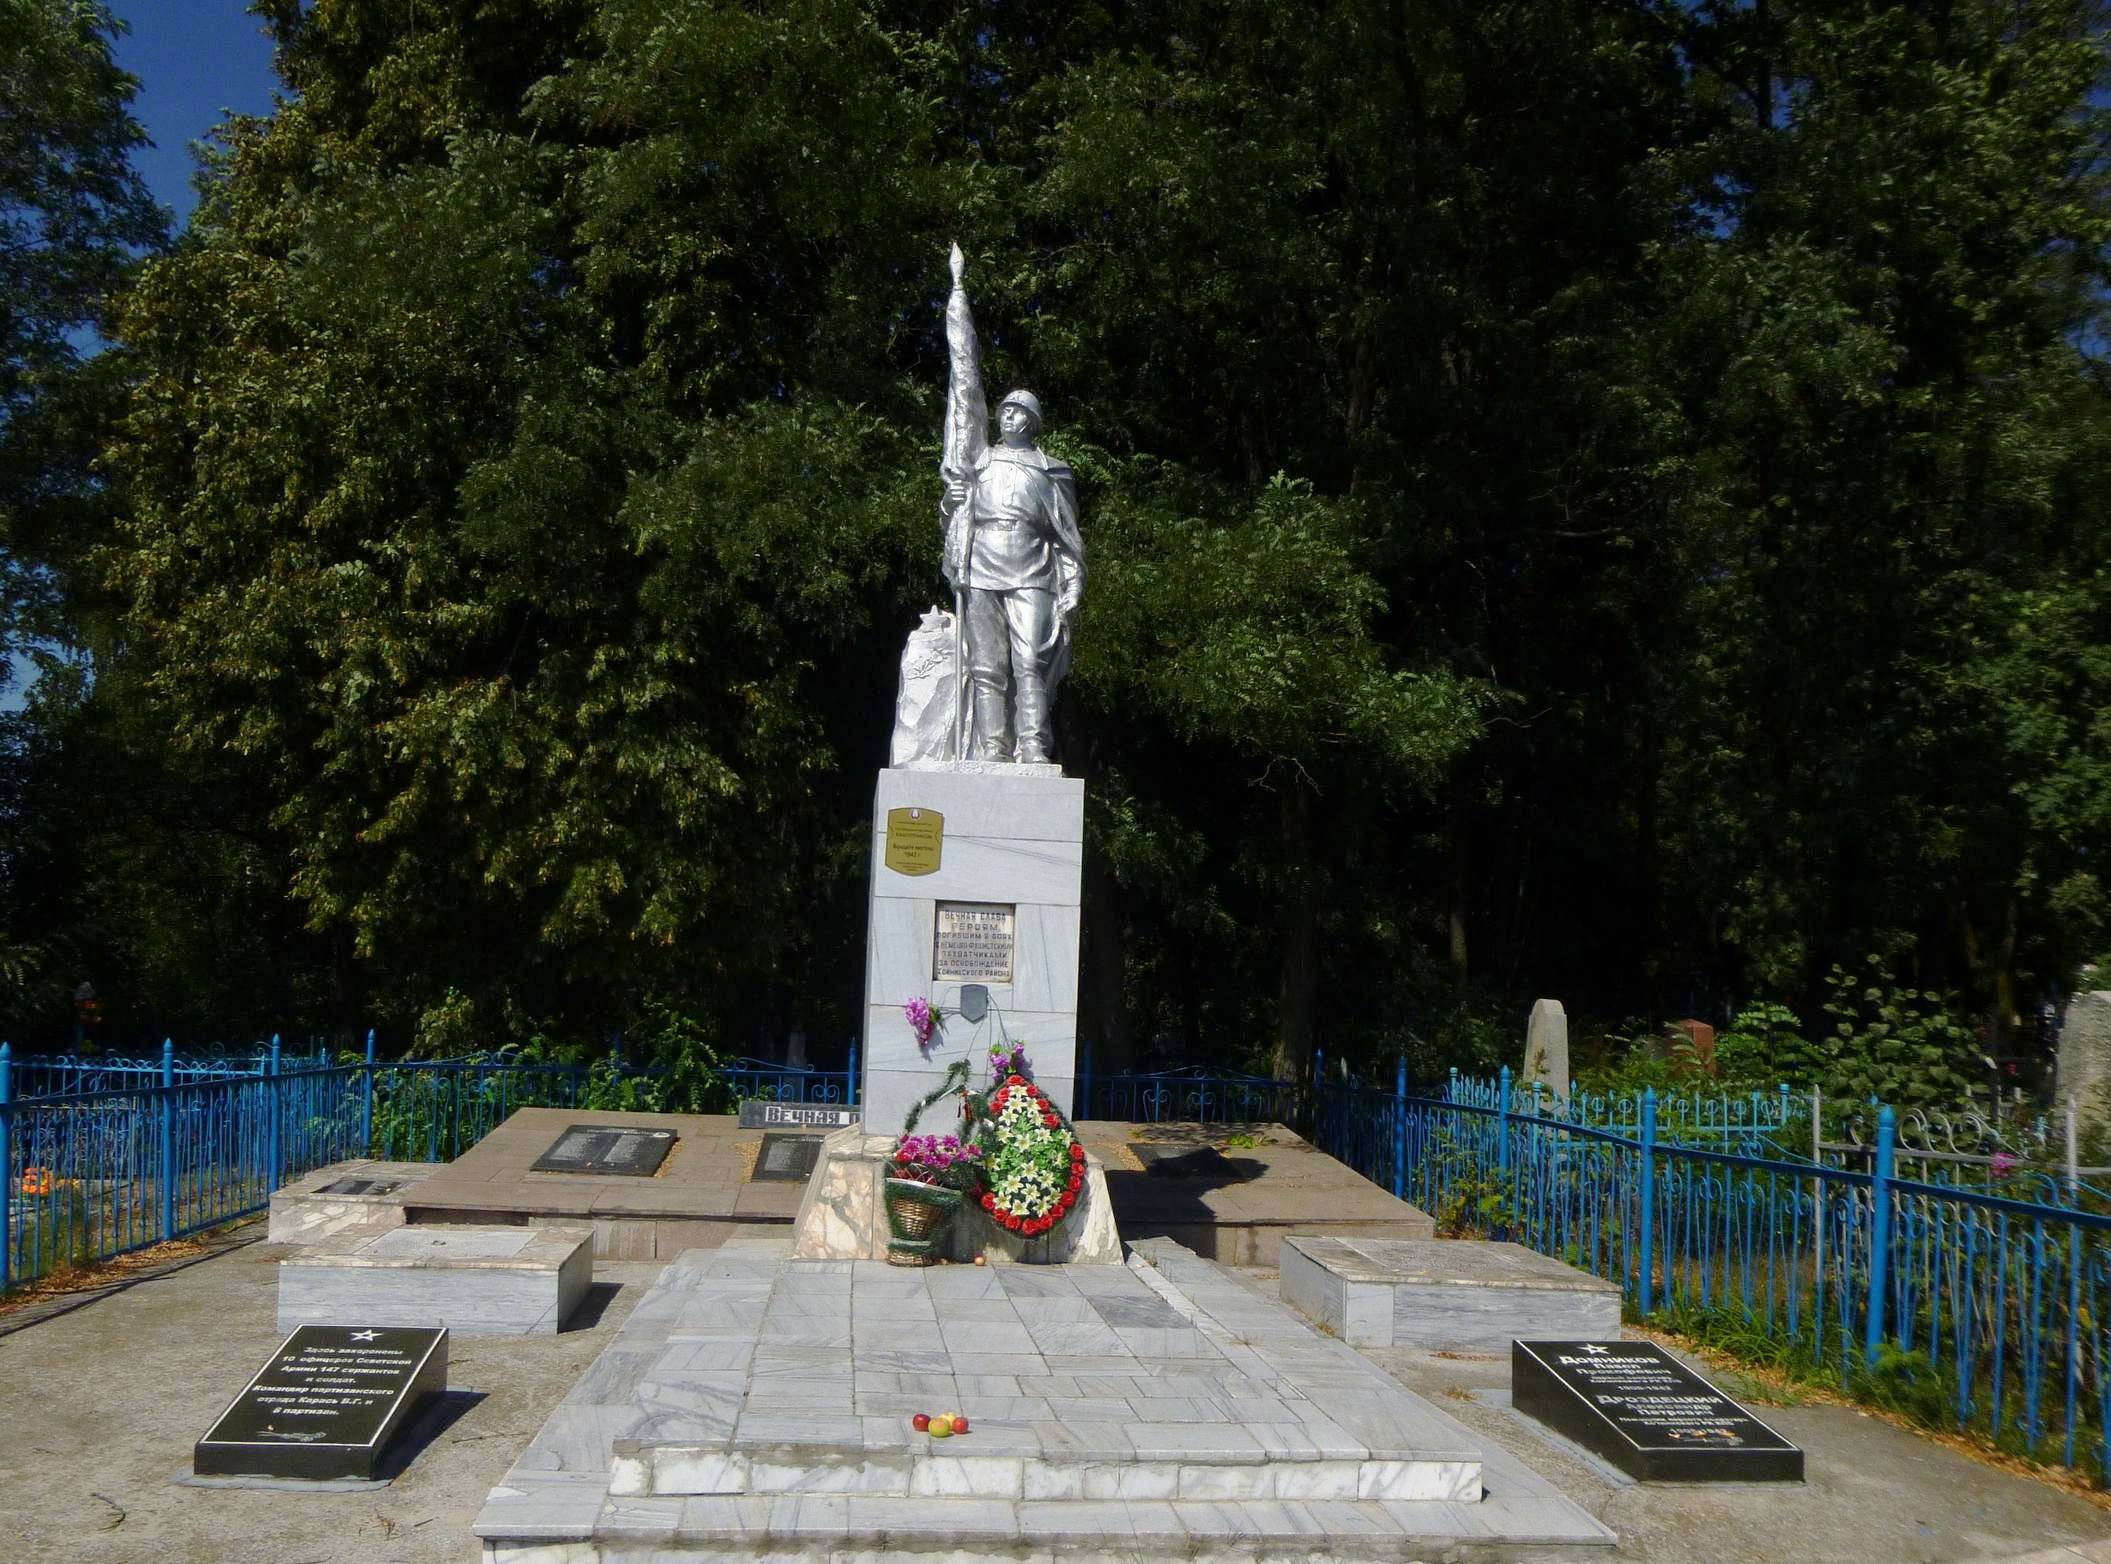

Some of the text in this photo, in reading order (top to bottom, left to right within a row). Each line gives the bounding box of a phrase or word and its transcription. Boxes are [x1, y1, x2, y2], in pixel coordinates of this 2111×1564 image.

[980, 912, 1006, 921] СЛАВА
[952, 923, 998, 931] ГЕРОЯМ
[942, 951, 1008, 959] ЗАХВАТЧИКАМИ
[950, 960, 1009, 968] ОСВОБОЖДЕНИЕ
[304, 1347, 404, 1356] Здесь захоронены
[299, 1356, 354, 1364] офицеров
[356, 1357, 412, 1365] Советской
[280, 1365, 317, 1373] Армии
[341, 1367, 401, 1375] сержантов
[252, 1385, 395, 1395] Командир партизанского
[256, 1396, 296, 1404] отряда
[298, 1397, 339, 1405] Карась
[283, 1408, 340, 1416] партизан.
